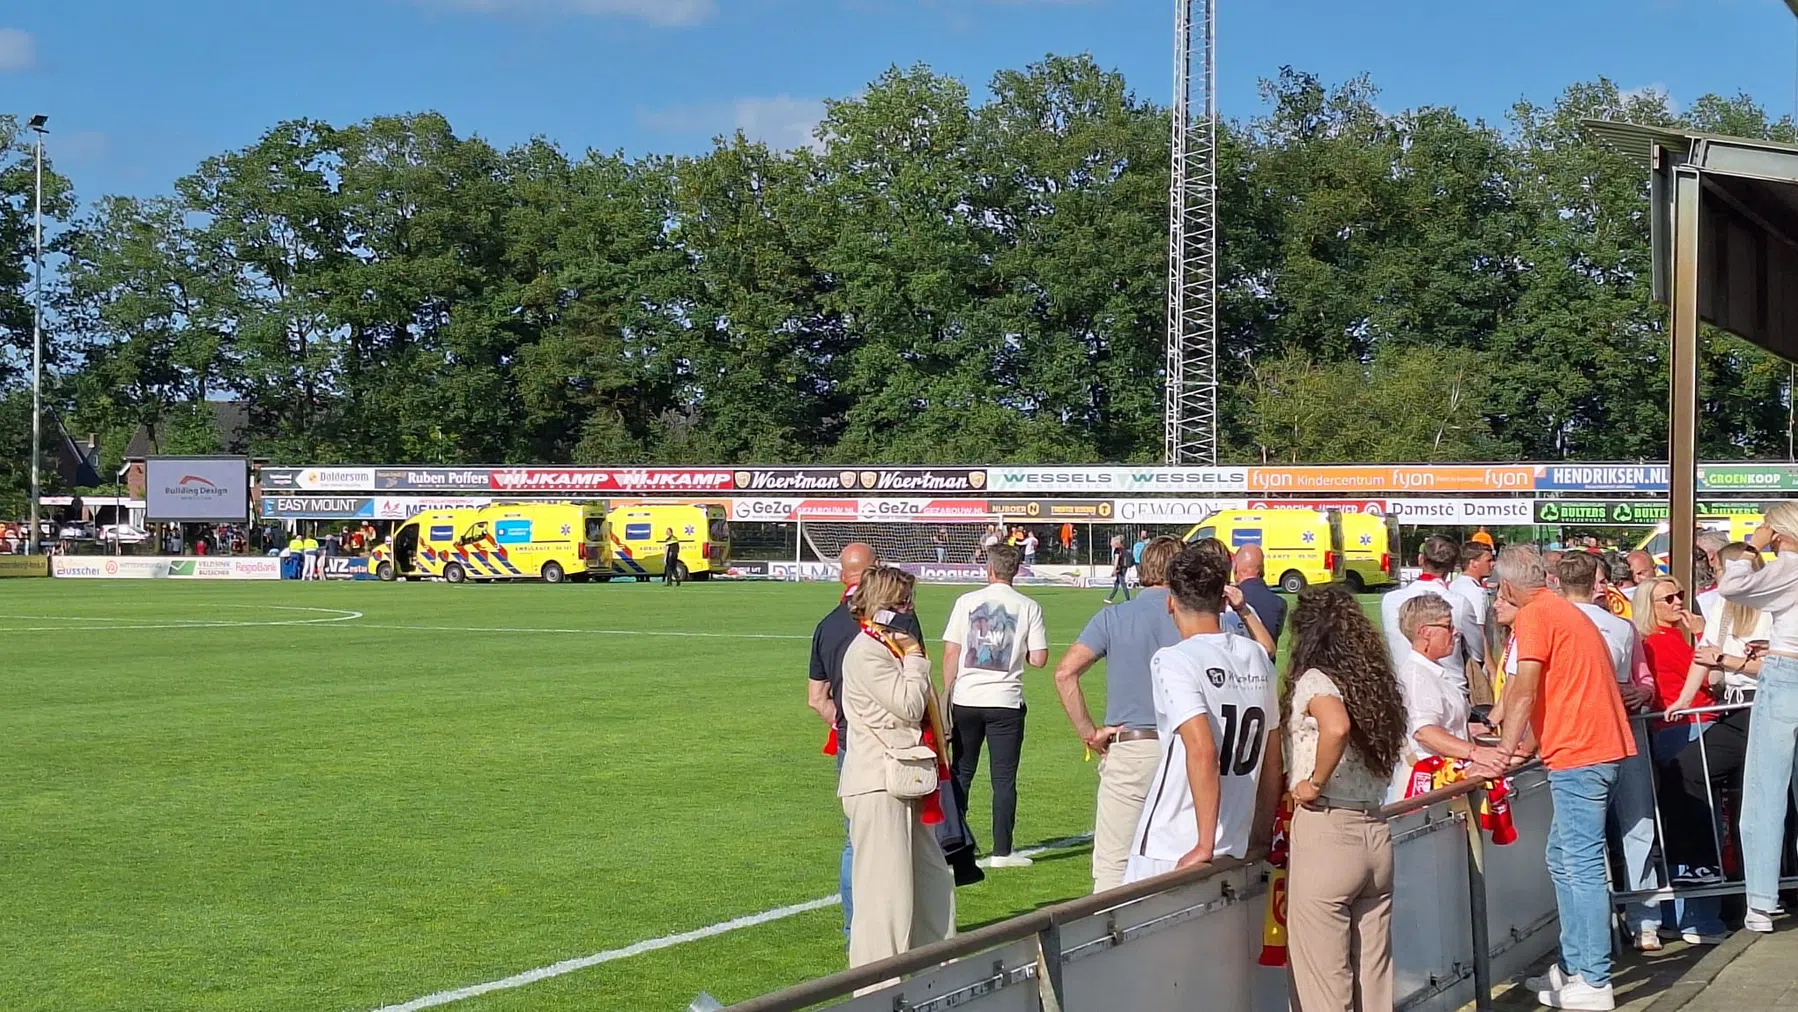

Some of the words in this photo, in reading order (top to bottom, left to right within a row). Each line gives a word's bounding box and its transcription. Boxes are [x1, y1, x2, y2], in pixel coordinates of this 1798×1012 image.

[408, 471, 445, 484] Ruben
[448, 471, 489, 484] Poffers
[752, 471, 840, 489] Woertman
[878, 471, 969, 489] Woertman
[1003, 473, 1112, 483] WESSELS
[1132, 473, 1245, 483] WESSELS
[1253, 470, 1292, 489] fyon
[1298, 475, 1385, 486] Kindercentrum
[1393, 469, 1434, 488] fyon
[1485, 468, 1528, 488] fyon
[1553, 468, 1669, 484] HENDRIKSEN.NL
[1709, 474, 1781, 484] GROENKOOP
[165, 487, 198, 495] Building
[200, 487, 228, 496] Design
[278, 499, 308, 511] EASY
[312, 499, 357, 511] MOUNT
[753, 501, 792, 514] GeZa
[879, 502, 919, 514] GeZa
[1392, 502, 1454, 516] Damsté
[1464, 502, 1527, 516] Damsté
[1219, 703, 1266, 777] 10
